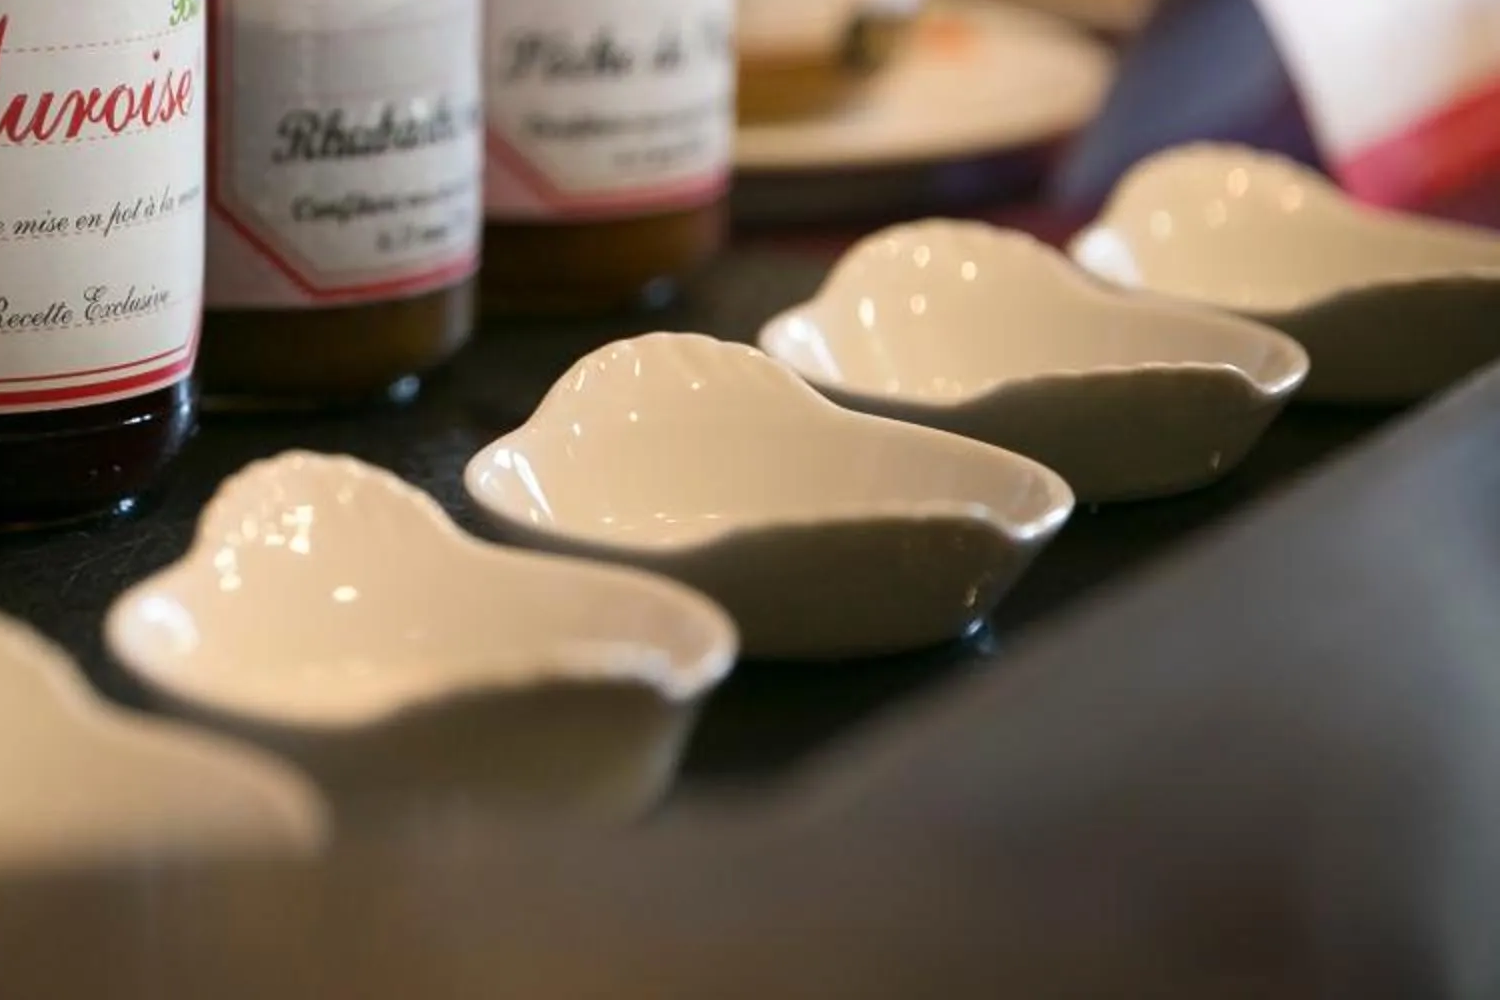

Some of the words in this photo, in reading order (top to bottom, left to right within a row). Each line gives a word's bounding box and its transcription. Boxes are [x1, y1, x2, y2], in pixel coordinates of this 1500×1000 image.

[13, 209, 69, 235] mise
[76, 213, 102, 231] en
[104, 198, 143, 237] pot
[144, 195, 155, 217] à
